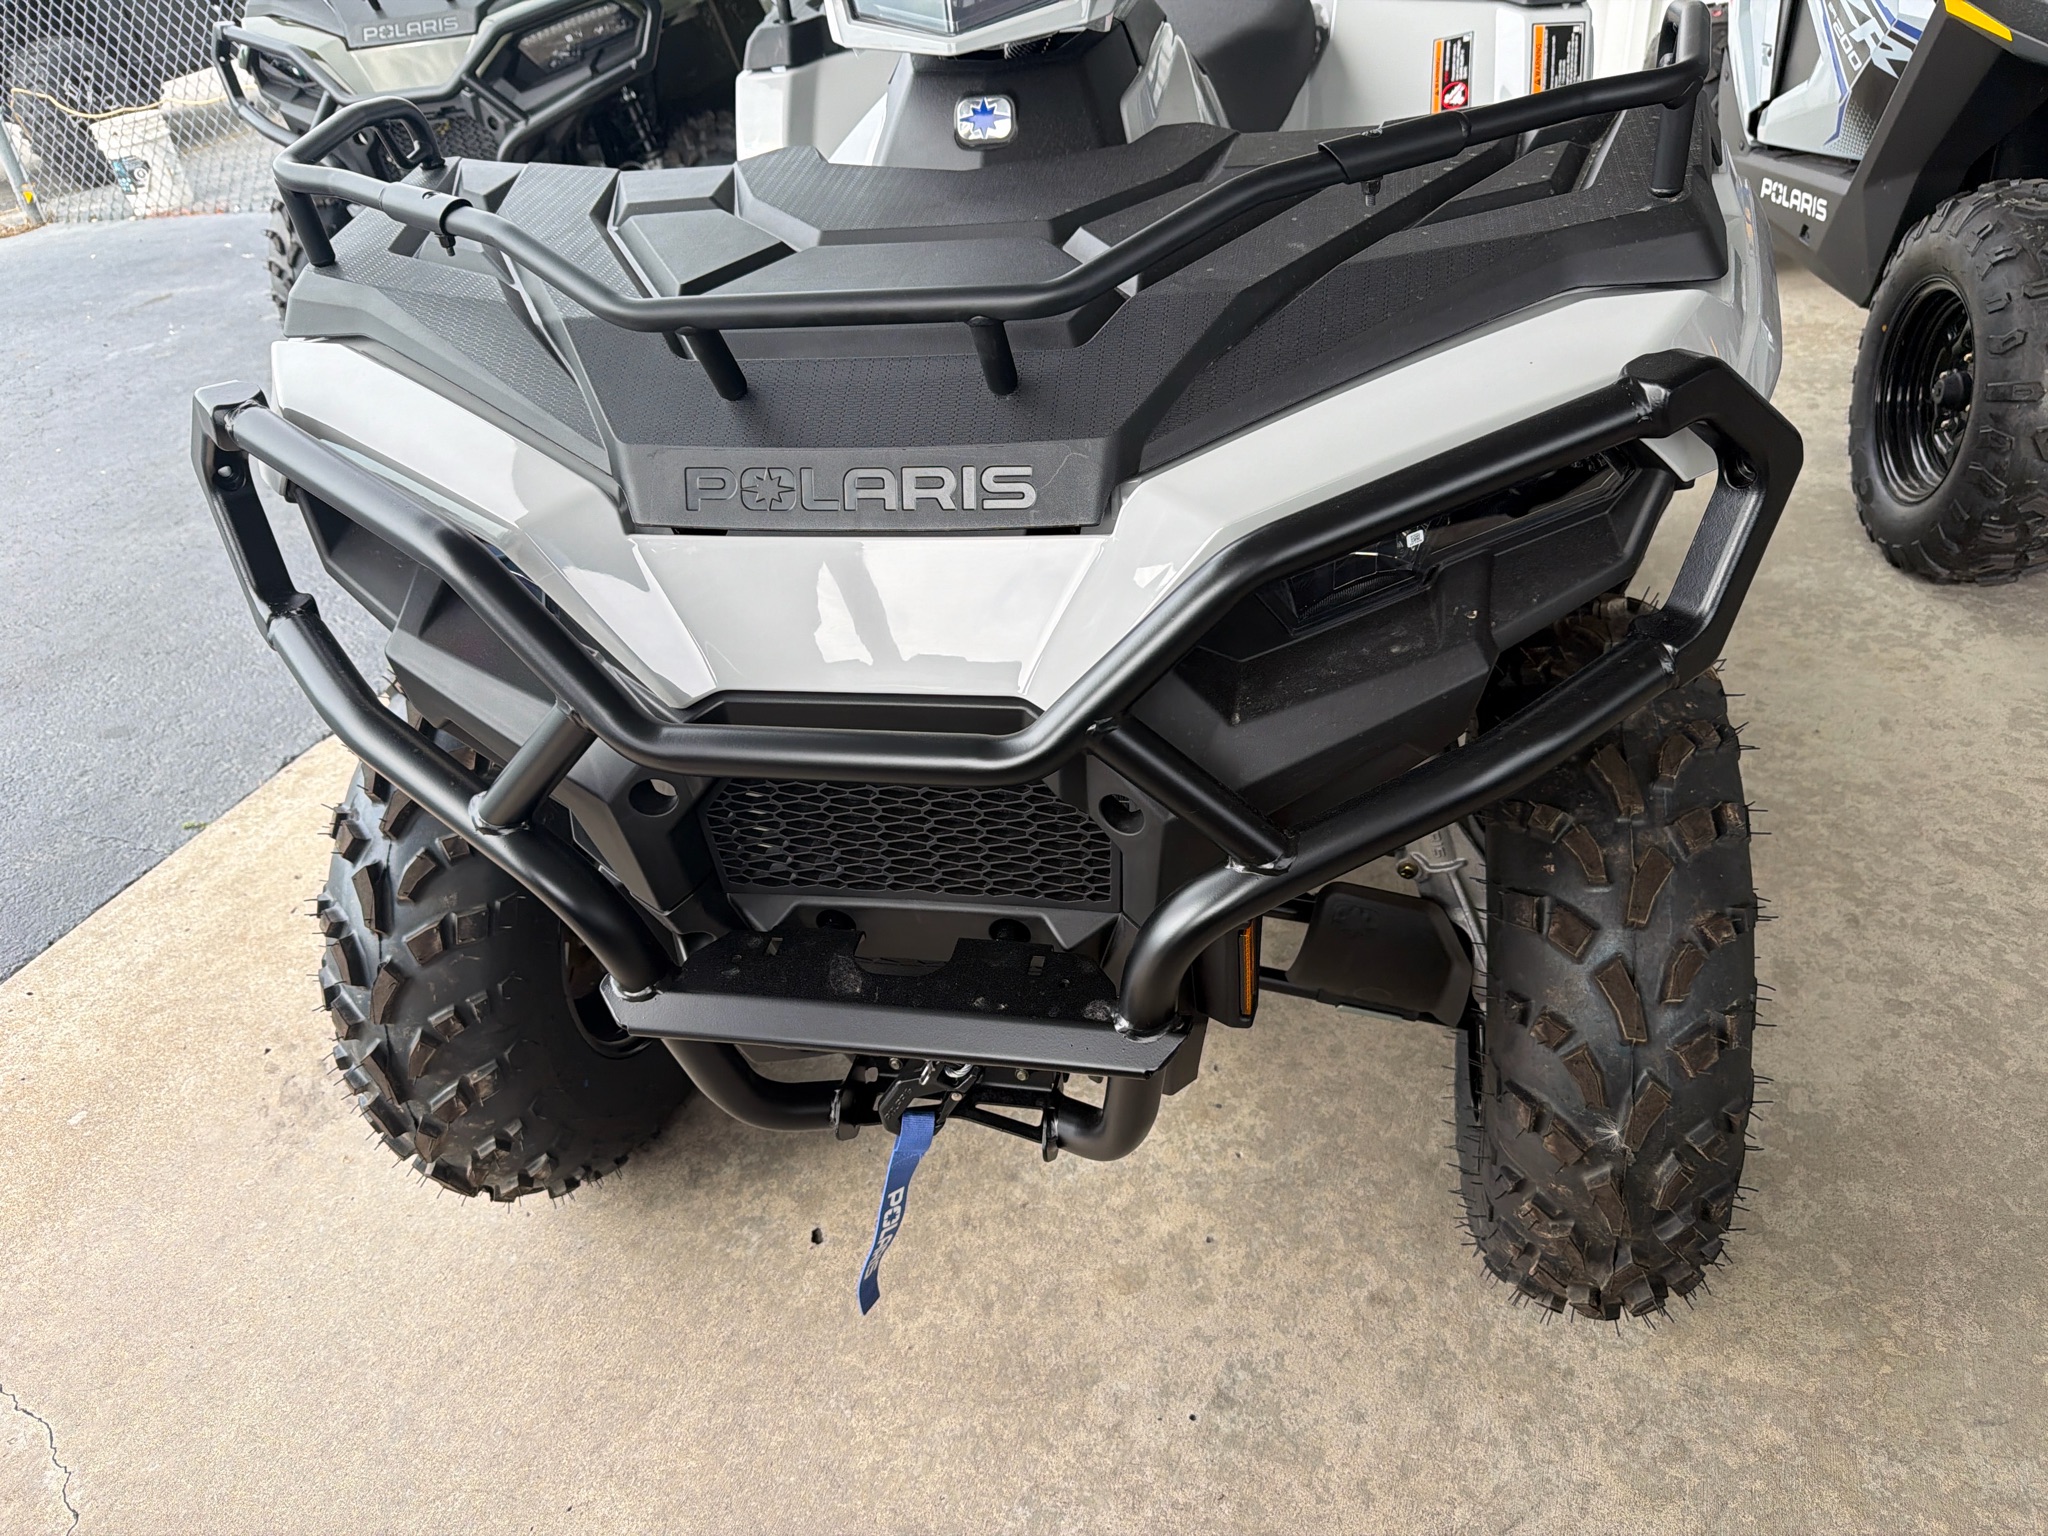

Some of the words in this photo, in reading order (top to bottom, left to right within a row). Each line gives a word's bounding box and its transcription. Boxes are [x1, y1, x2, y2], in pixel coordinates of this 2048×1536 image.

[363, 17, 459, 42] POLARIS
[1833, 18, 1862, 71] 200
[1760, 177, 1828, 222] POLARIS
[684, 464, 1037, 512] POLARIS
[864, 1186, 905, 1280] POLARIS
